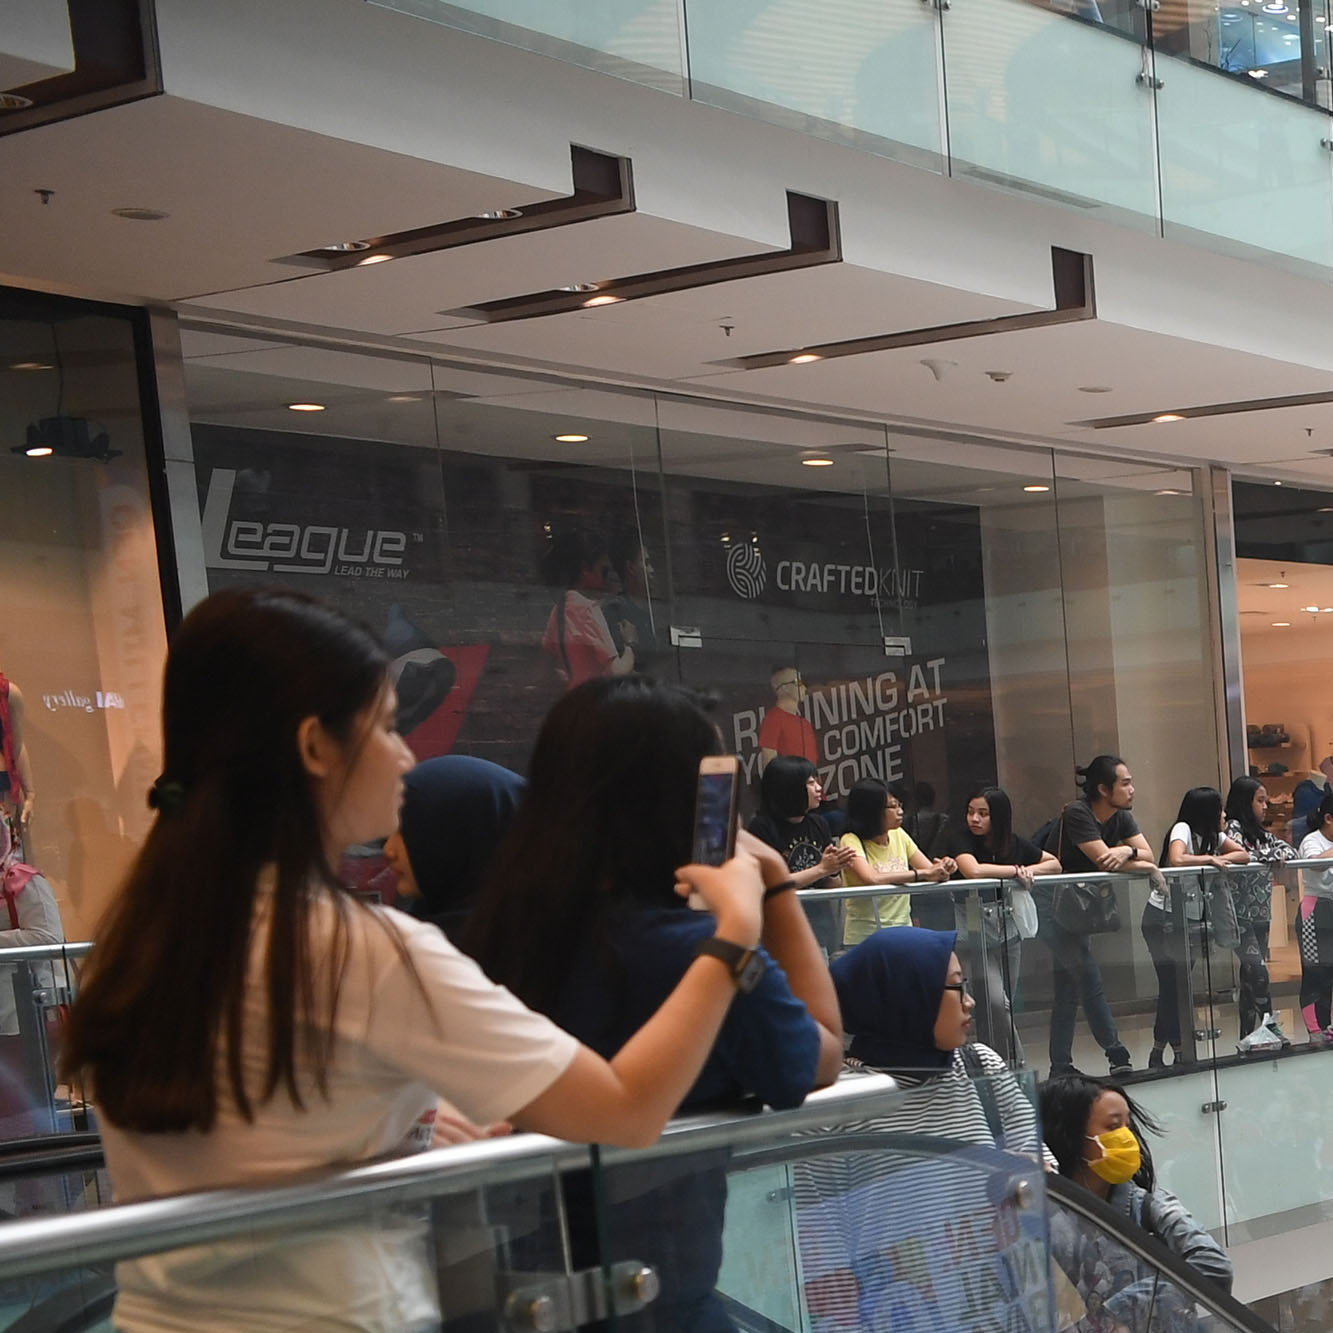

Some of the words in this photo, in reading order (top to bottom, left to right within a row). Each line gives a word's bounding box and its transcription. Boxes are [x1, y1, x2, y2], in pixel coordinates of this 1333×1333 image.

[202, 468, 407, 575] League
[335, 565, 362, 576] LEAD
[365, 567, 385, 578] THE
[387, 569, 409, 580] WAY
[907, 657, 946, 704] AT
[823, 698, 947, 762] COMFORT
